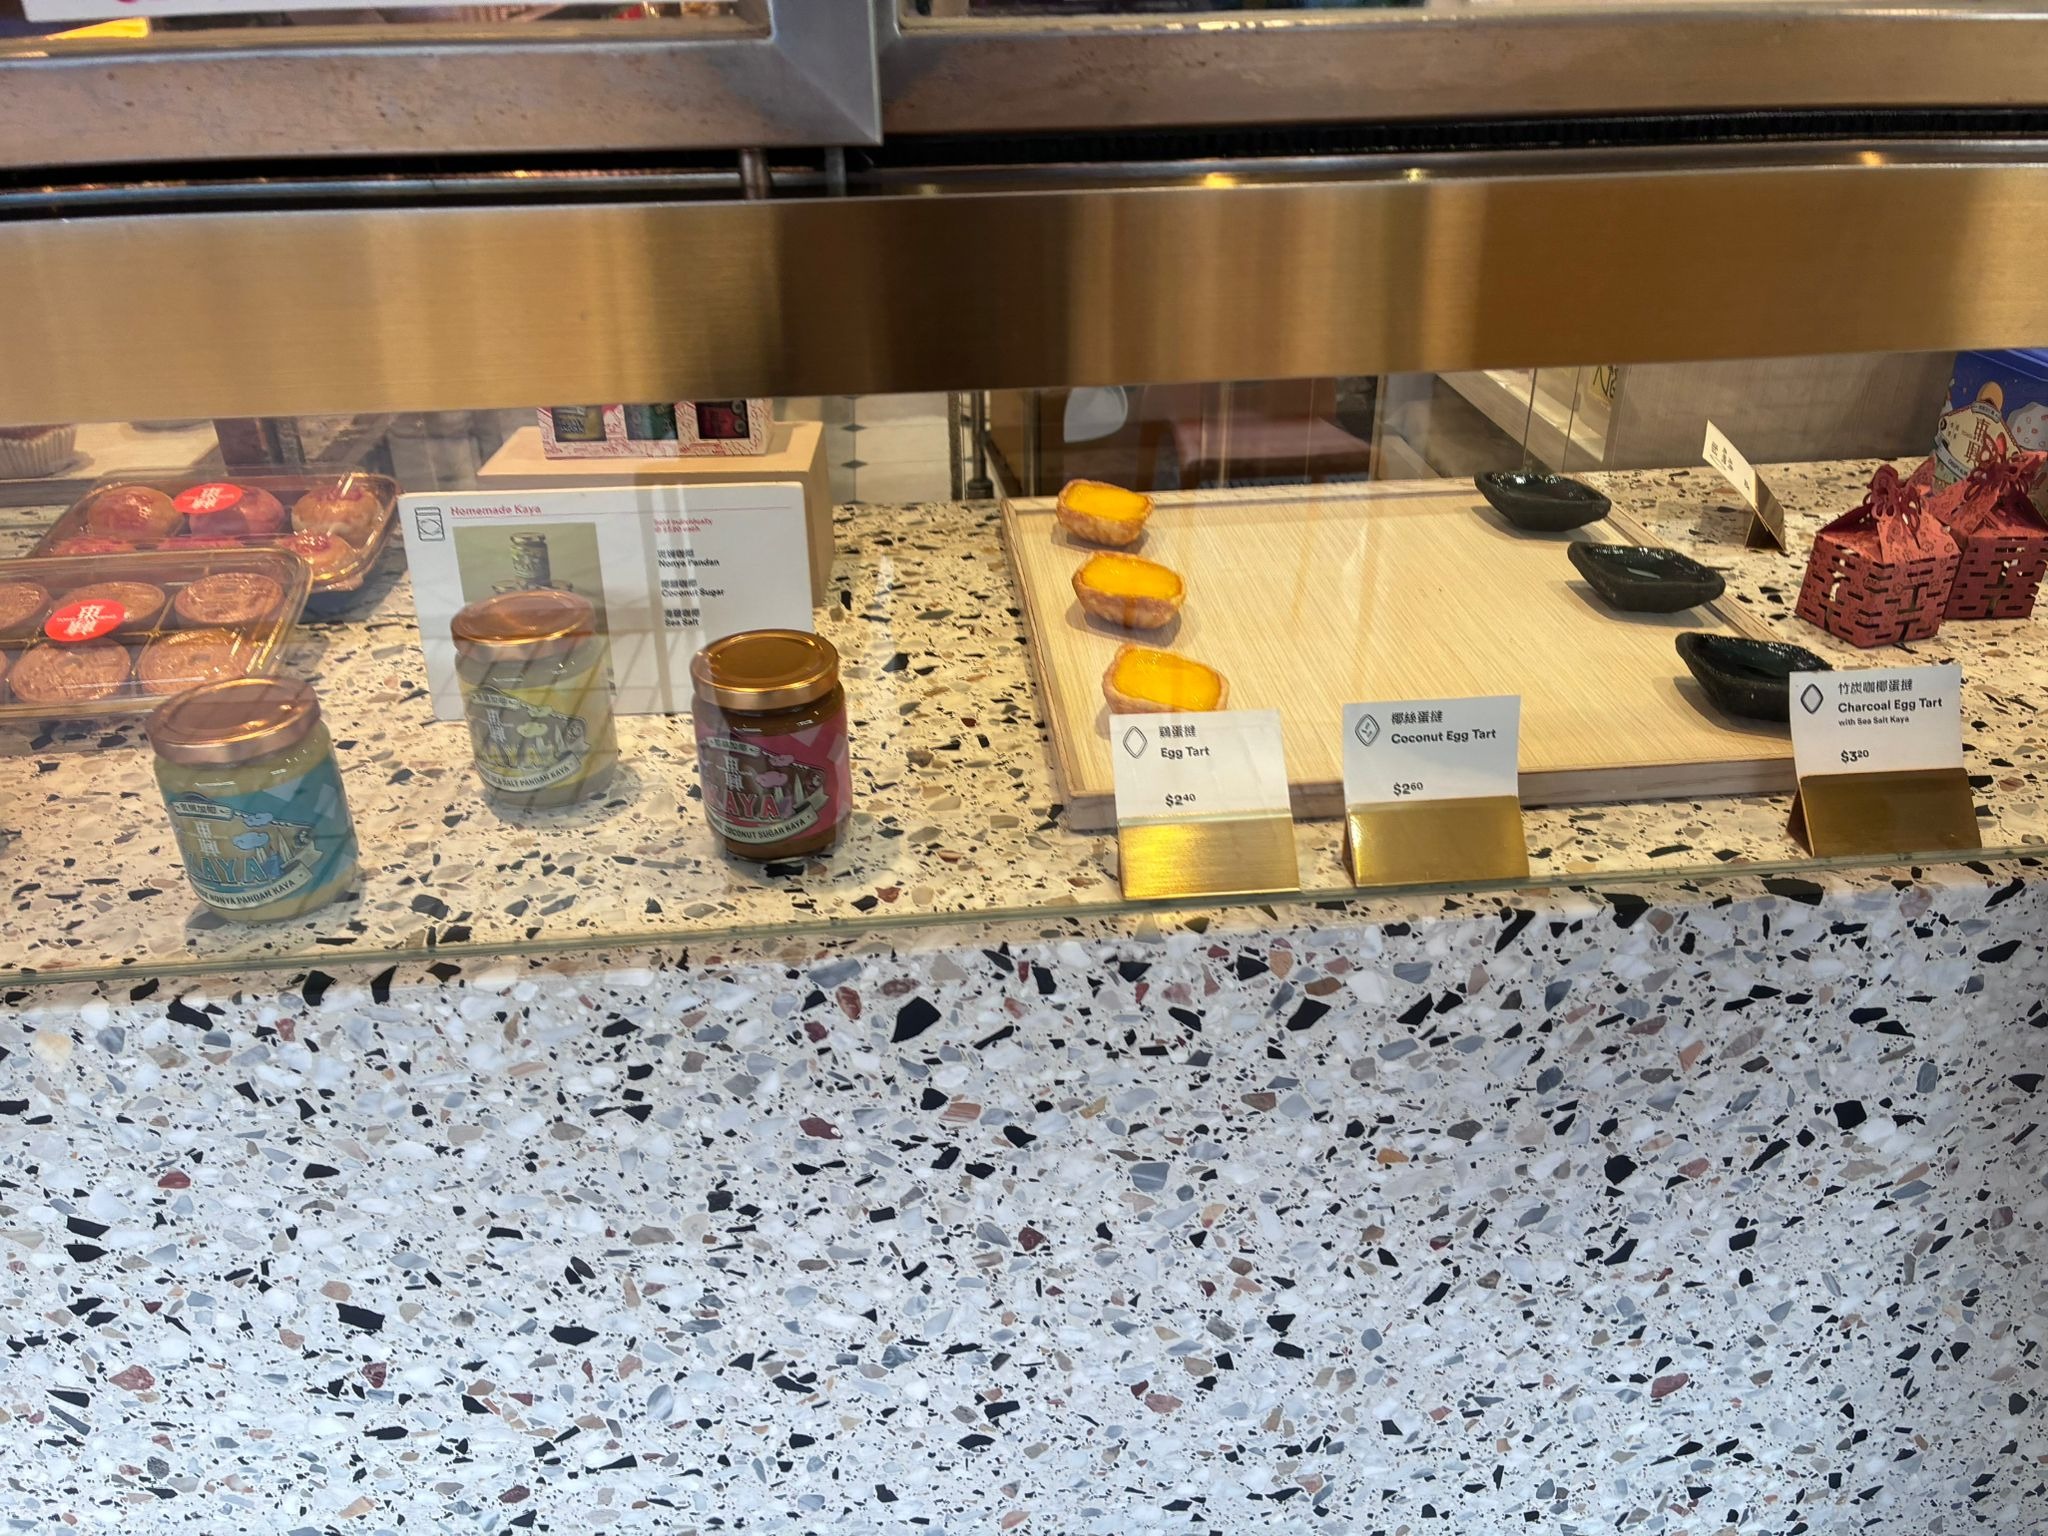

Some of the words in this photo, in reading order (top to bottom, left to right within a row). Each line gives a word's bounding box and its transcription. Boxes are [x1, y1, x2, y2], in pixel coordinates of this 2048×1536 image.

[450, 505, 513, 516] Homemade
[514, 504, 542, 516] Kaya
[1838, 699, 1891, 713] Charcoal
[1894, 699, 1916, 711] Egg
[1919, 697, 1942, 708] Tart
[1838, 718, 1856, 726] with
[1857, 717, 1872, 726] Sea
[1873, 716, 1889, 724] Salt
[1890, 715, 1910, 724] Kaya
[1391, 732, 1444, 744] Coconut
[1446, 730, 1469, 742] Egg
[1472, 728, 1496, 740] Tart
[1160, 747, 1184, 760] Egg
[1185, 746, 1210, 757] Tart
[758, 826, 785, 840] SUGAR
[786, 818, 807, 833] KAYA
[273, 879, 296, 896] KAYA
